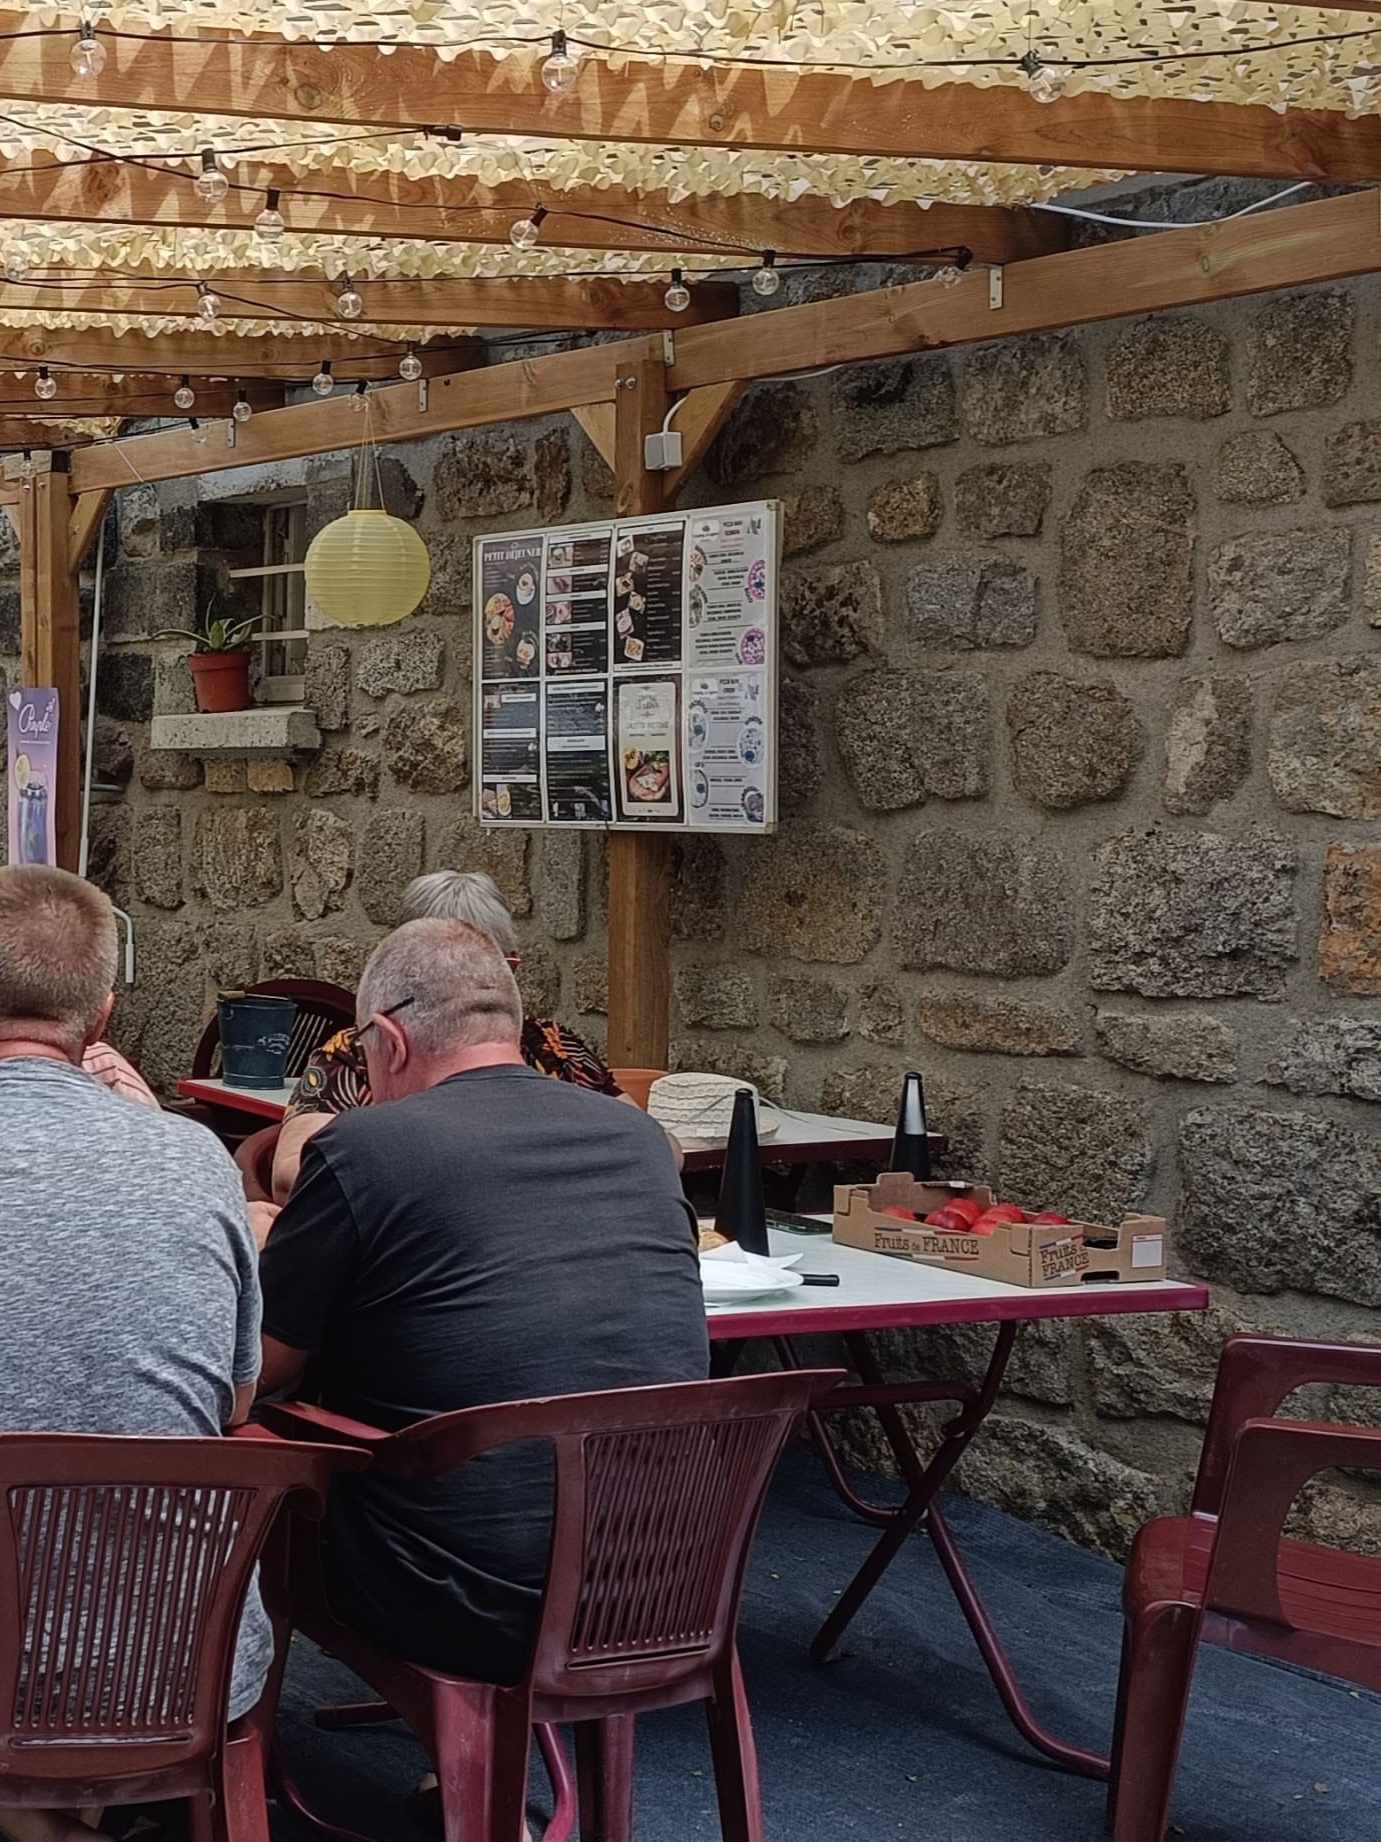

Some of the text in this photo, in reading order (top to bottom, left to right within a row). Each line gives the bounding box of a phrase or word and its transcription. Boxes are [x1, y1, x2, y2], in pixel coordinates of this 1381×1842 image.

[874, 1233, 910, 1250] Fruits
[922, 1236, 980, 1255] FRANCE
[1040, 1244, 1078, 1263] Fruits
[1042, 1252, 1090, 1276] FRANCE
